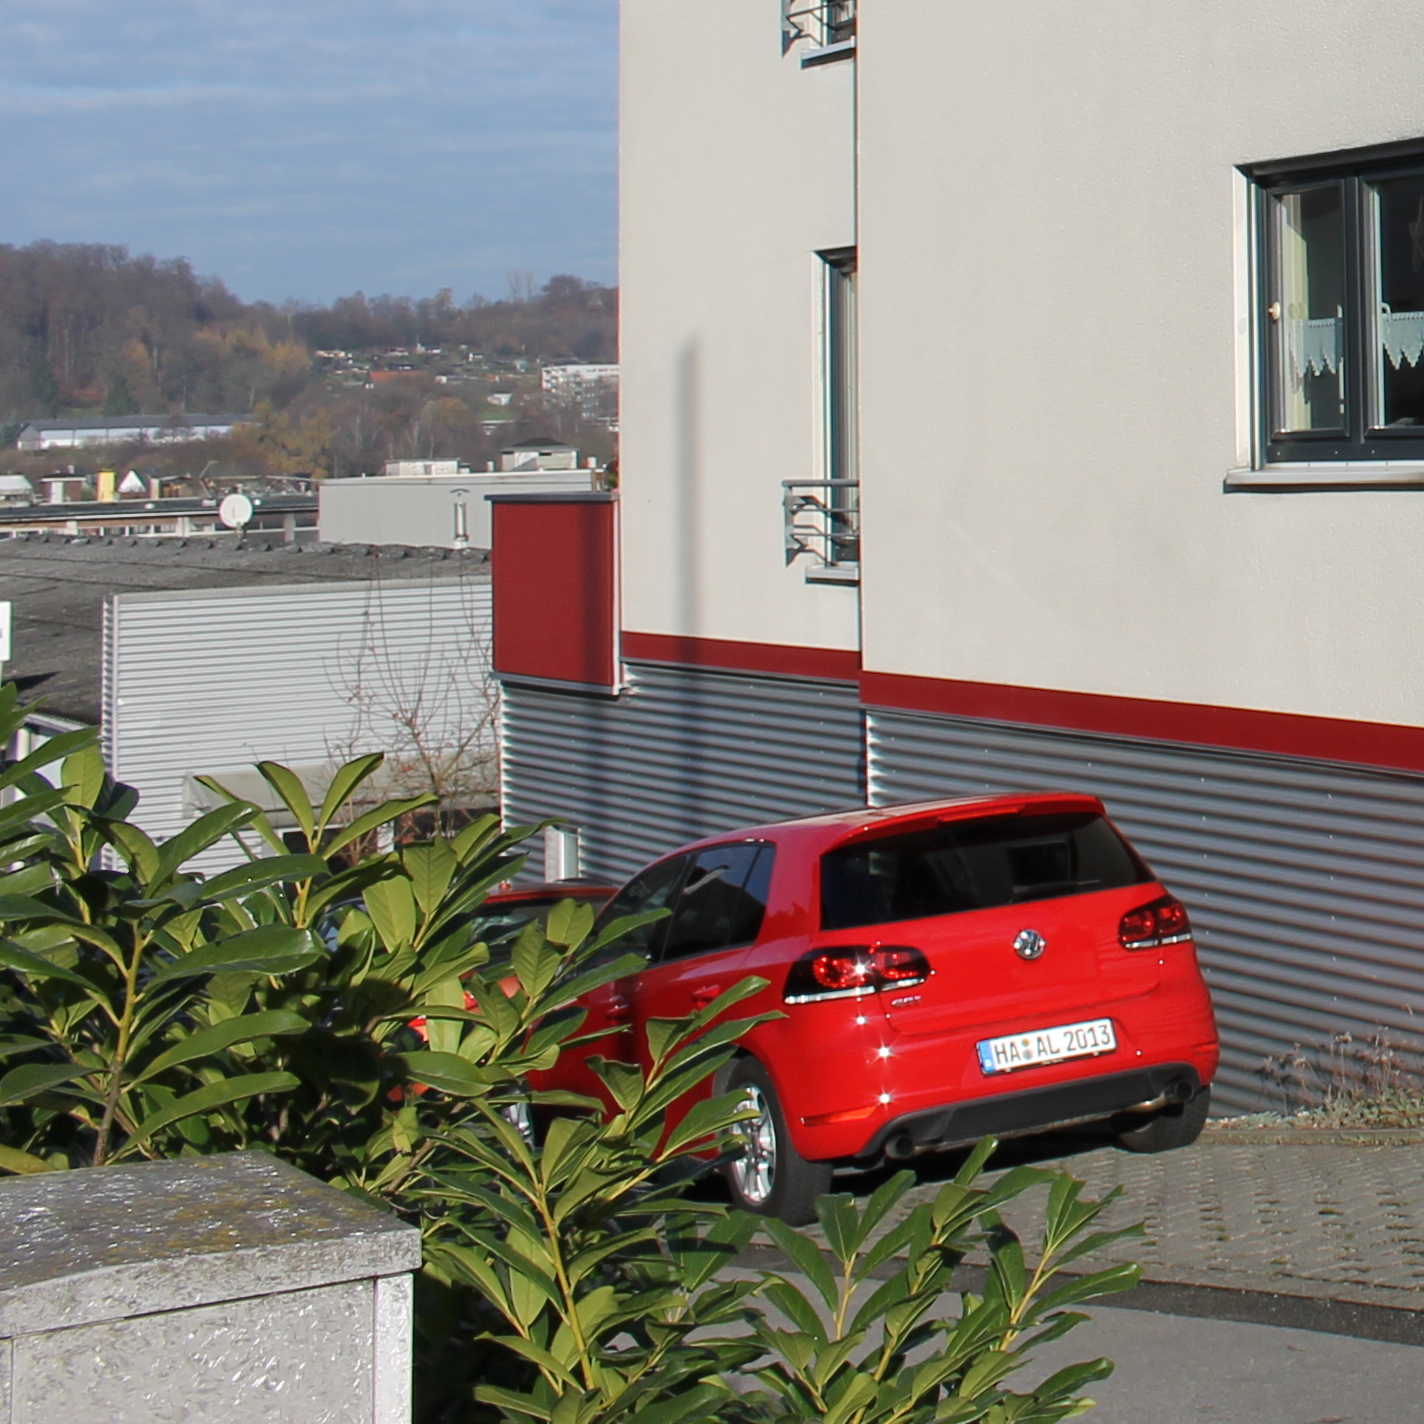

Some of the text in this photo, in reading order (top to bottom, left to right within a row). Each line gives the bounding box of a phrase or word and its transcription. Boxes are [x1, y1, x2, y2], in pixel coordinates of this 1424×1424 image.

[994, 1024, 1111, 1065] HA AL 2013
